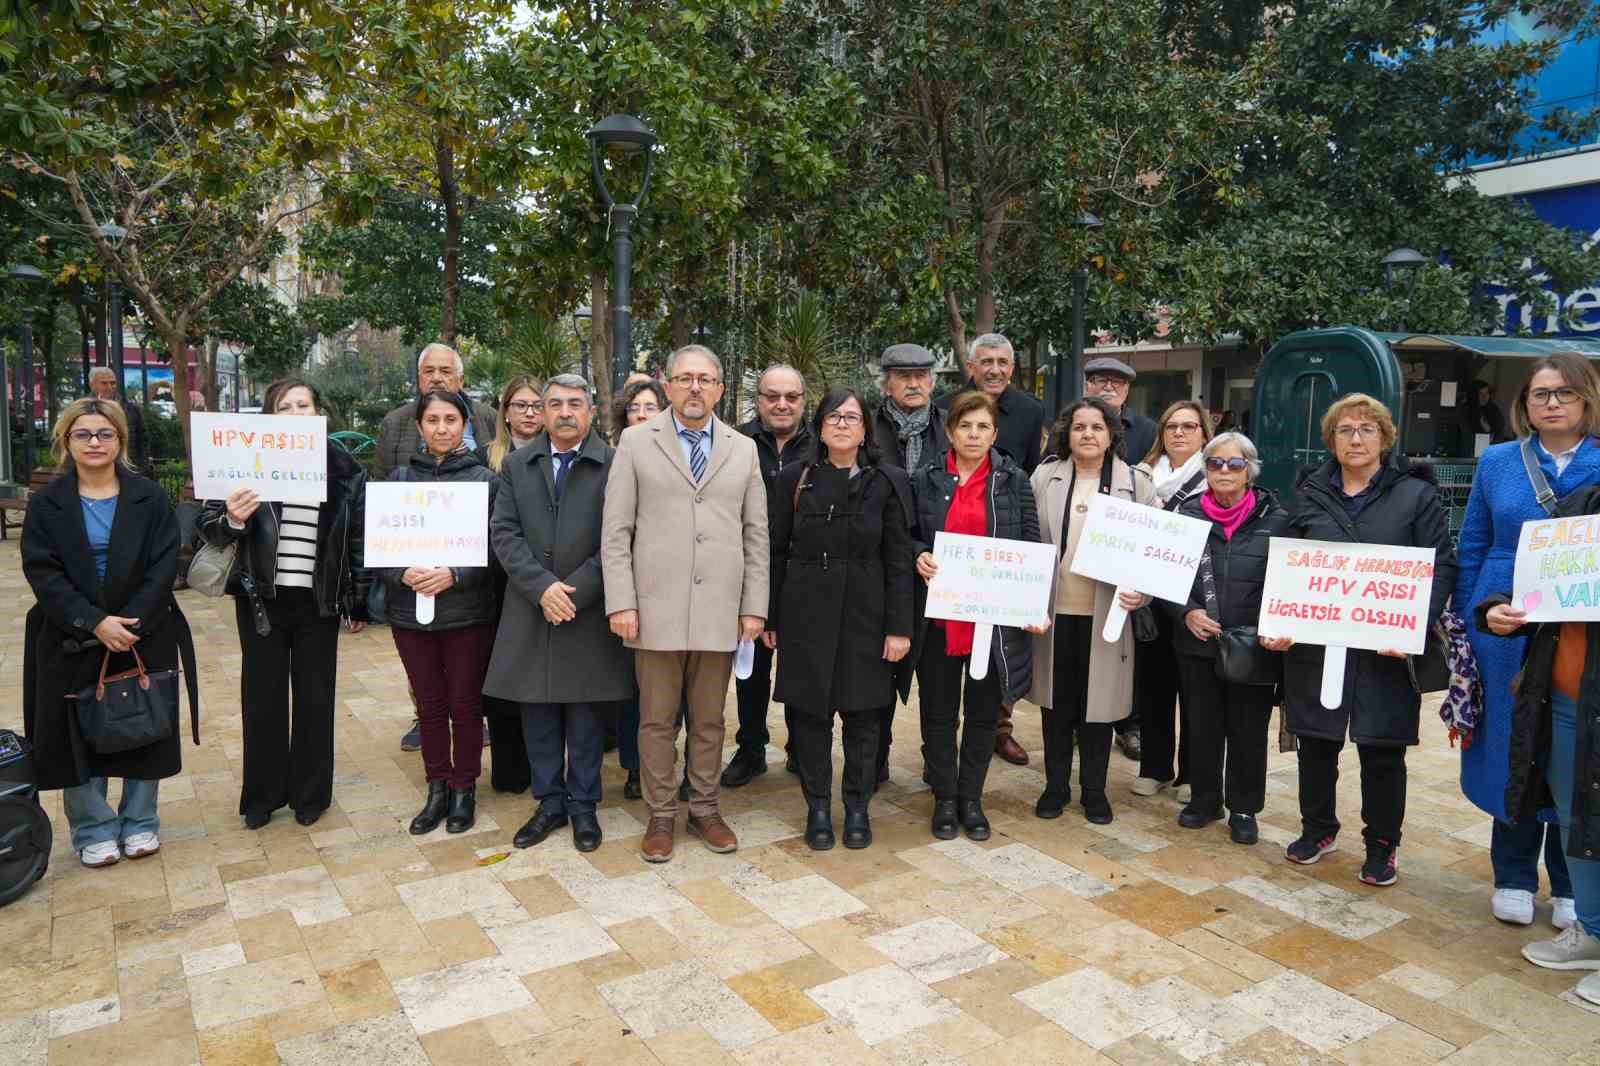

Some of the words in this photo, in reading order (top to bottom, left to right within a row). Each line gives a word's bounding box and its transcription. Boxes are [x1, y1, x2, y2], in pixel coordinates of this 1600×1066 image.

[211, 428, 257, 449] HPV
[943, 545, 977, 560] HER
[1143, 545, 1199, 570] SAĞLIK
[1286, 549, 1350, 571] SAĞLIK
[1308, 575, 1358, 596] HPV
[1361, 579, 1417, 602] AŞISI
[1266, 597, 1343, 622] ÜCRETSİZ
[1350, 607, 1417, 631] OLSUN
